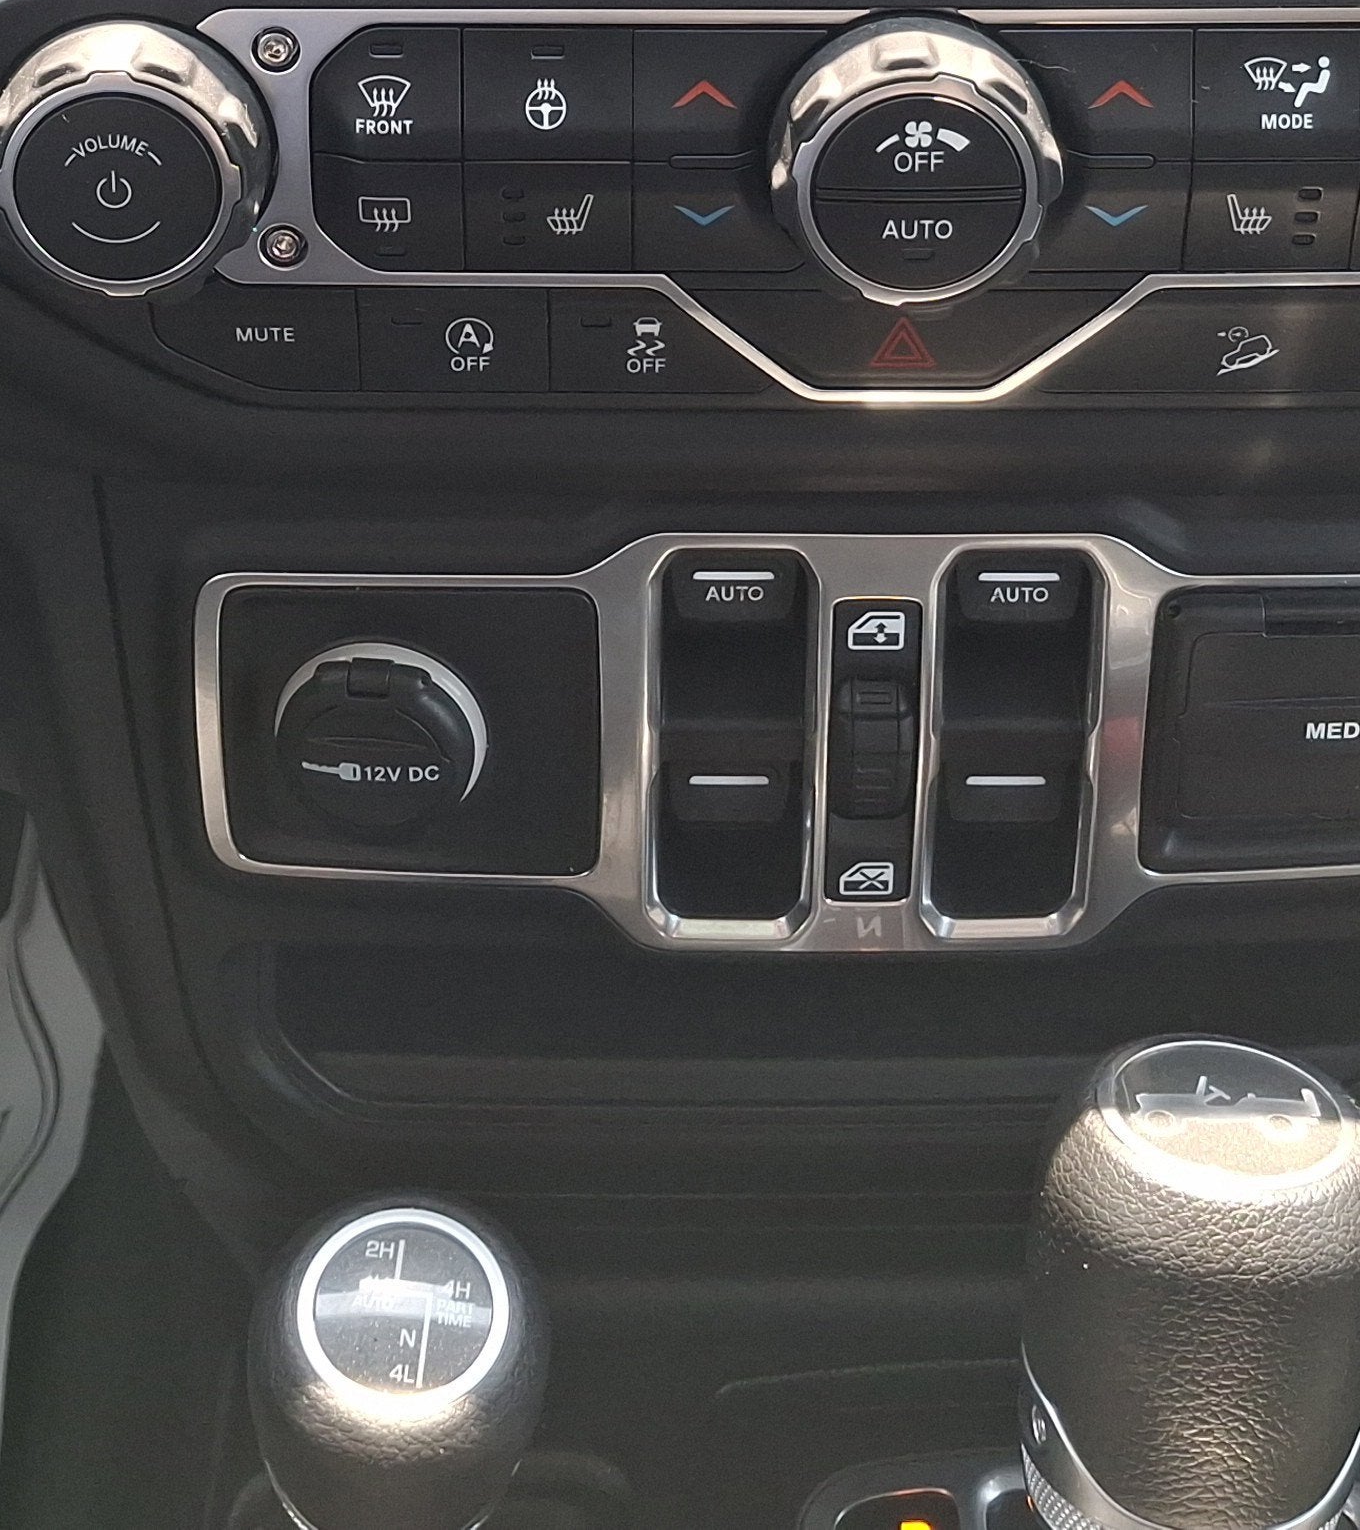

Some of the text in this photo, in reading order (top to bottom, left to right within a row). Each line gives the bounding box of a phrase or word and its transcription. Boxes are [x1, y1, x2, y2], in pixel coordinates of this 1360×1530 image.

[355, 118, 414, 136] FRONT
[1260, 112, 1314, 131] MODE
[72, 133, 150, 158] VOLUME
[893, 151, 945, 173] OFF
[881, 219, 954, 240] AUTO
[235, 326, 296, 343] MUTE
[449, 355, 491, 372] OFF
[625, 357, 667, 374] OFF
[704, 585, 765, 602] AUTO
[989, 586, 1050, 603] AUTO
[363, 764, 440, 782] 12V DC
[365, 1240, 395, 1259] 2H
[443, 1279, 471, 1300] 4H
[437, 1299, 476, 1314] PART
[437, 1313, 472, 1328] TIME
[399, 1327, 417, 1348] N
[389, 1363, 416, 1384] 4L
